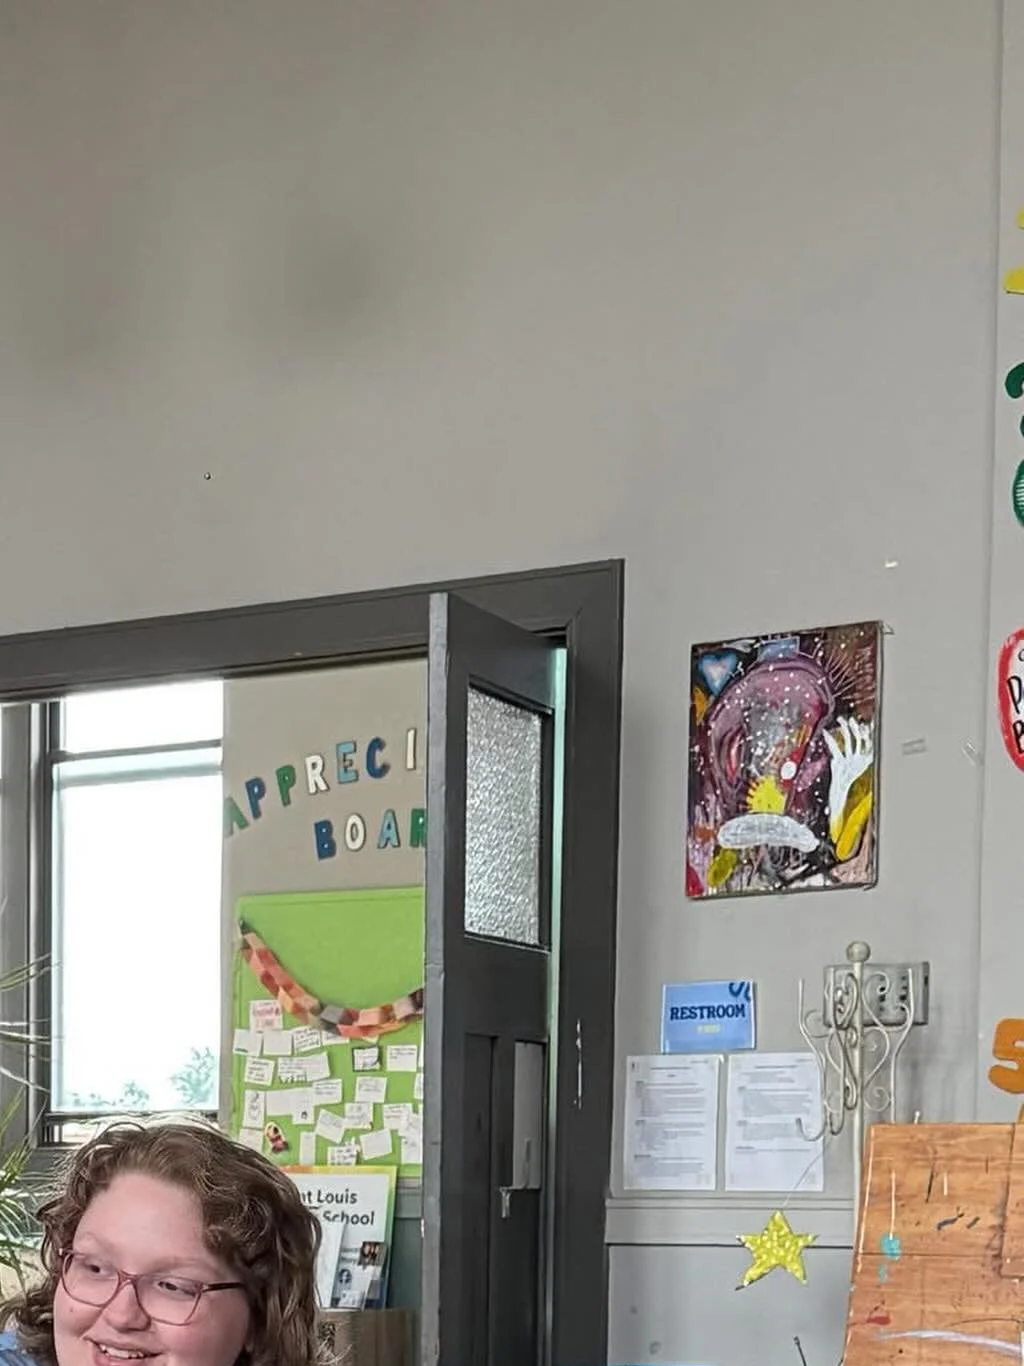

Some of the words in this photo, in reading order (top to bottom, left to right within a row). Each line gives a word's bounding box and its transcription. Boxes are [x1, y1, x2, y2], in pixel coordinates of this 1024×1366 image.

[669, 1003, 746, 1021] RESTROOM
[317, 1188, 358, 1204] Louis
[322, 1210, 375, 1225] School
